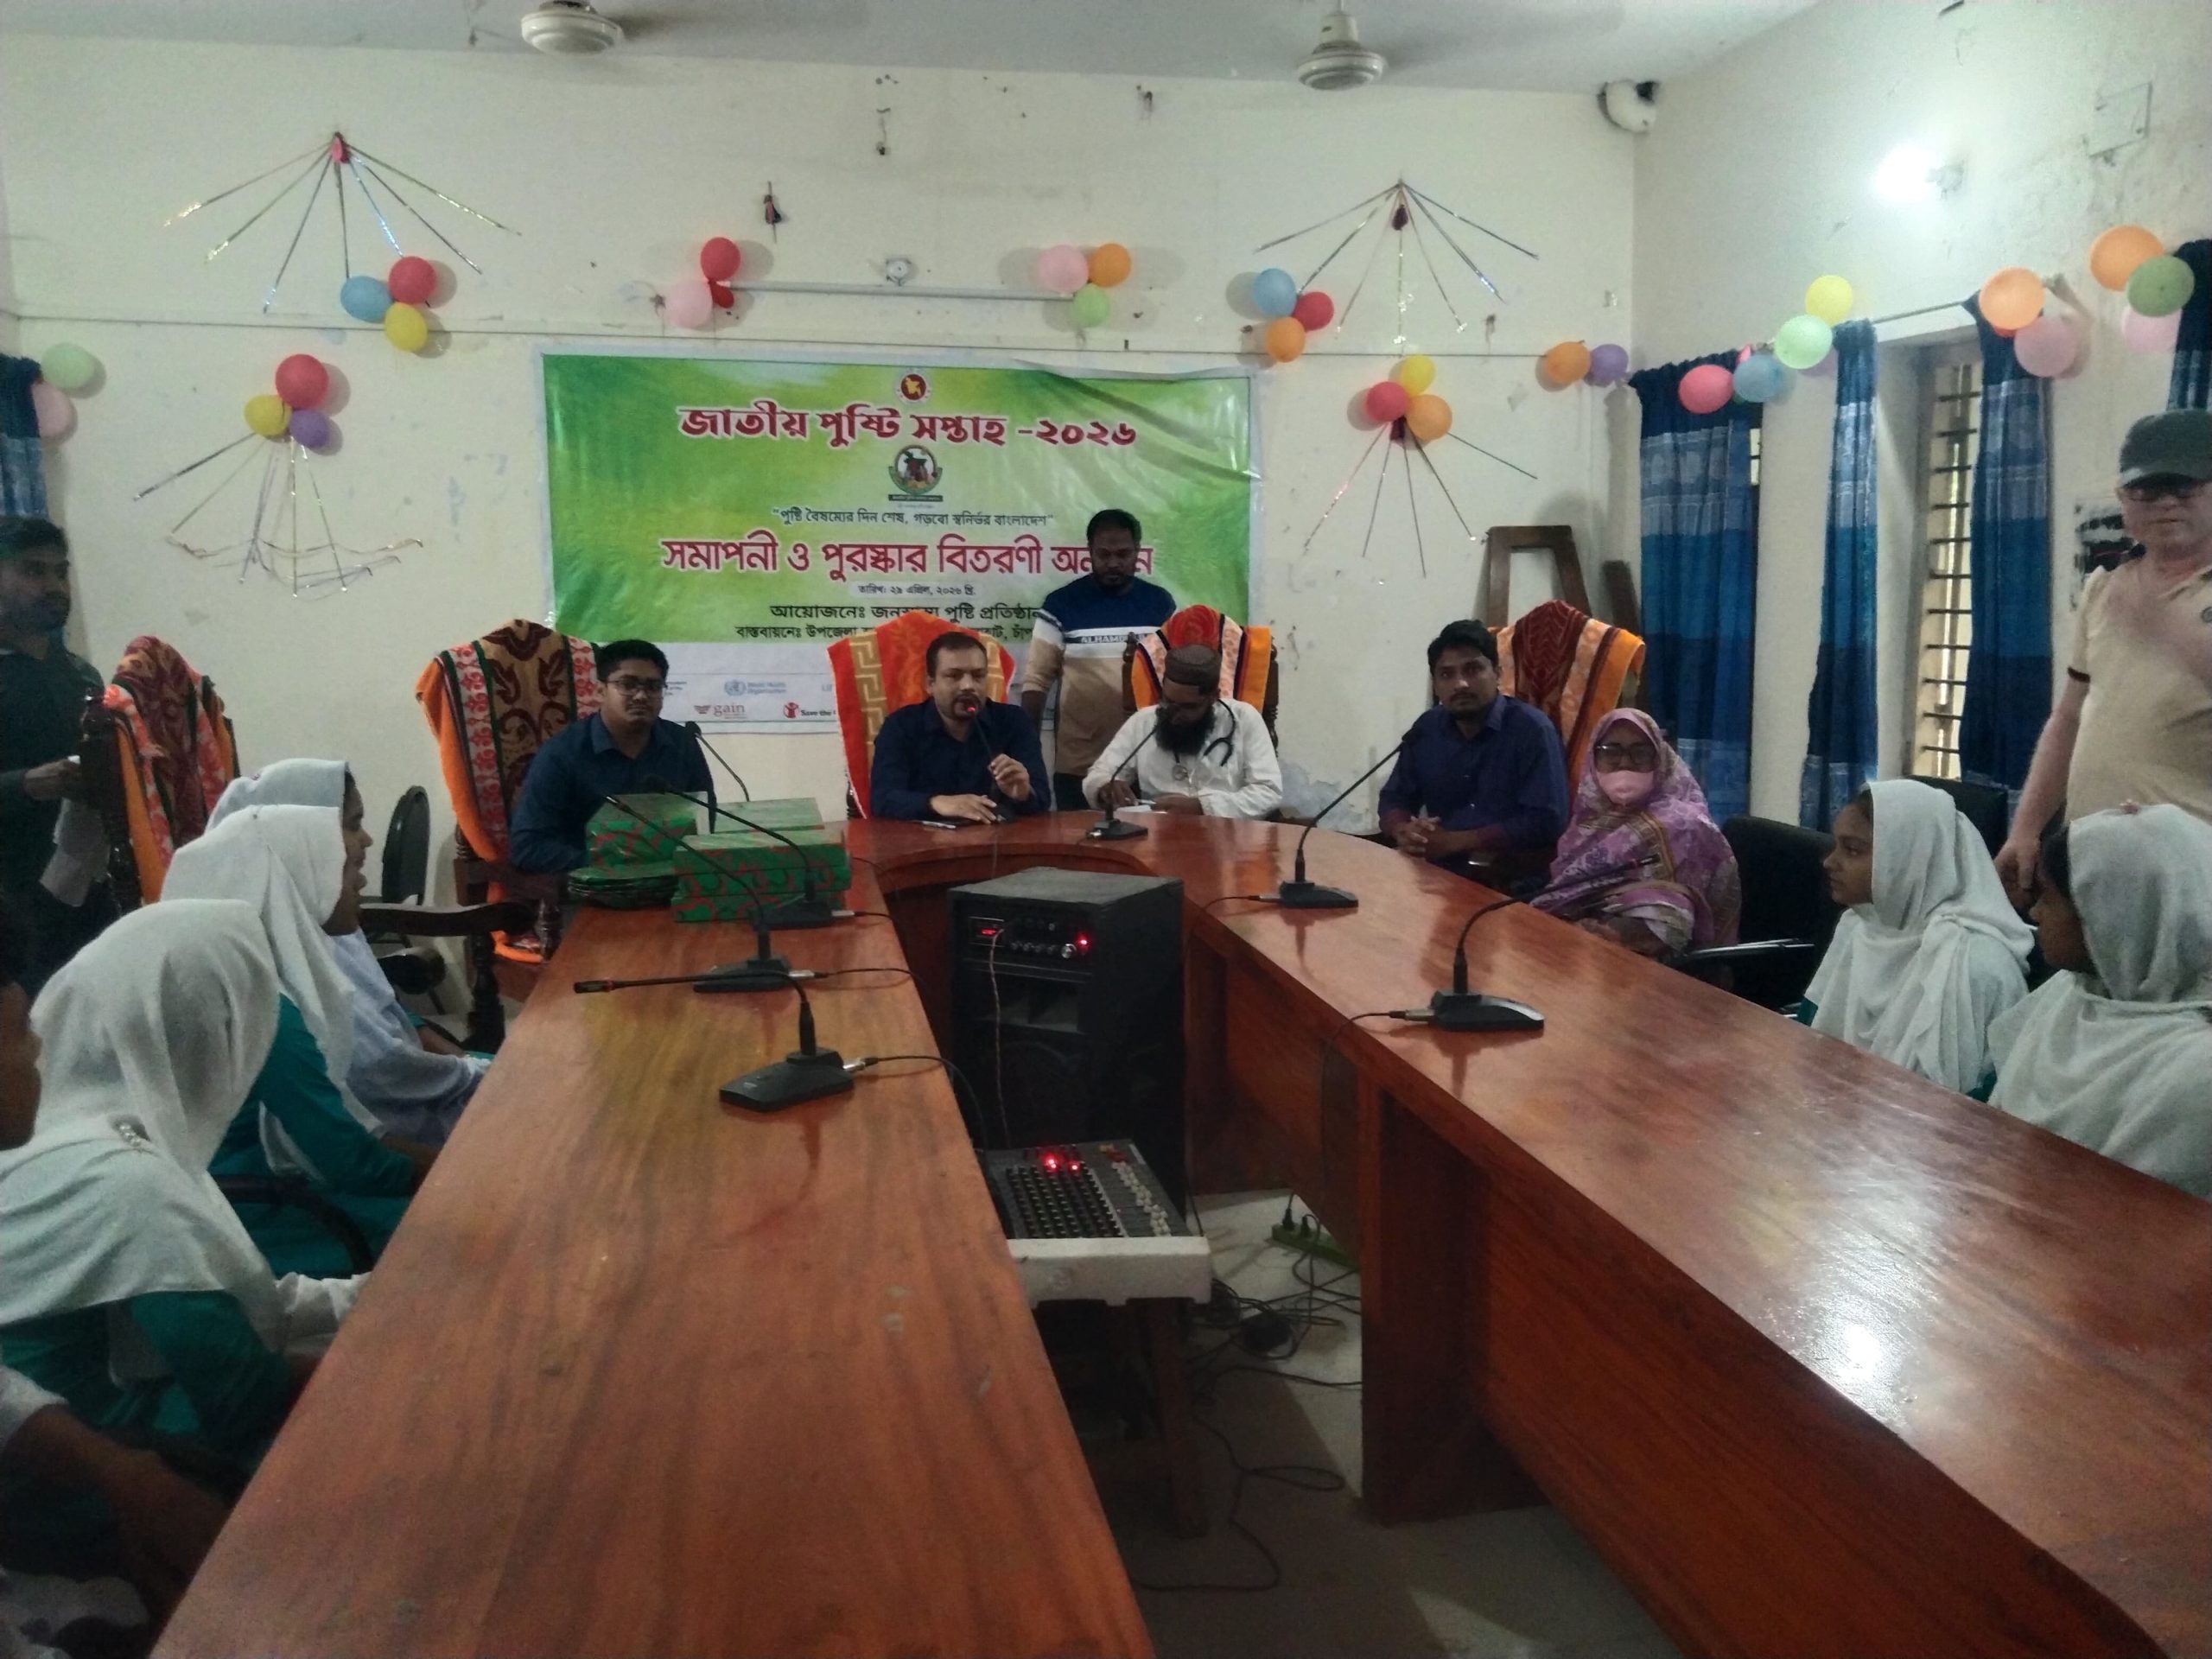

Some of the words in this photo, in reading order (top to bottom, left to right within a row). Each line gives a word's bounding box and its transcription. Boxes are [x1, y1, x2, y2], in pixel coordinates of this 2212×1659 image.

[678, 400, 810, 438] জাতীয়
[816, 404, 902, 448] পুষ্টি
[910, 414, 1007, 446] সপ্তাহ
[857, 508, 878, 524] দিন
[952, 511, 991, 525] স্বনির্ভর
[661, 530, 779, 571] সমাপনী
[787, 543, 810, 572] ও
[822, 543, 928, 582] পুরস্কার
[937, 533, 1043, 574] বিতরণী
[944, 602, 976, 623] পুষ্টি
[805, 624, 858, 639] উপজেলা
[714, 702, 745, 716] gain
